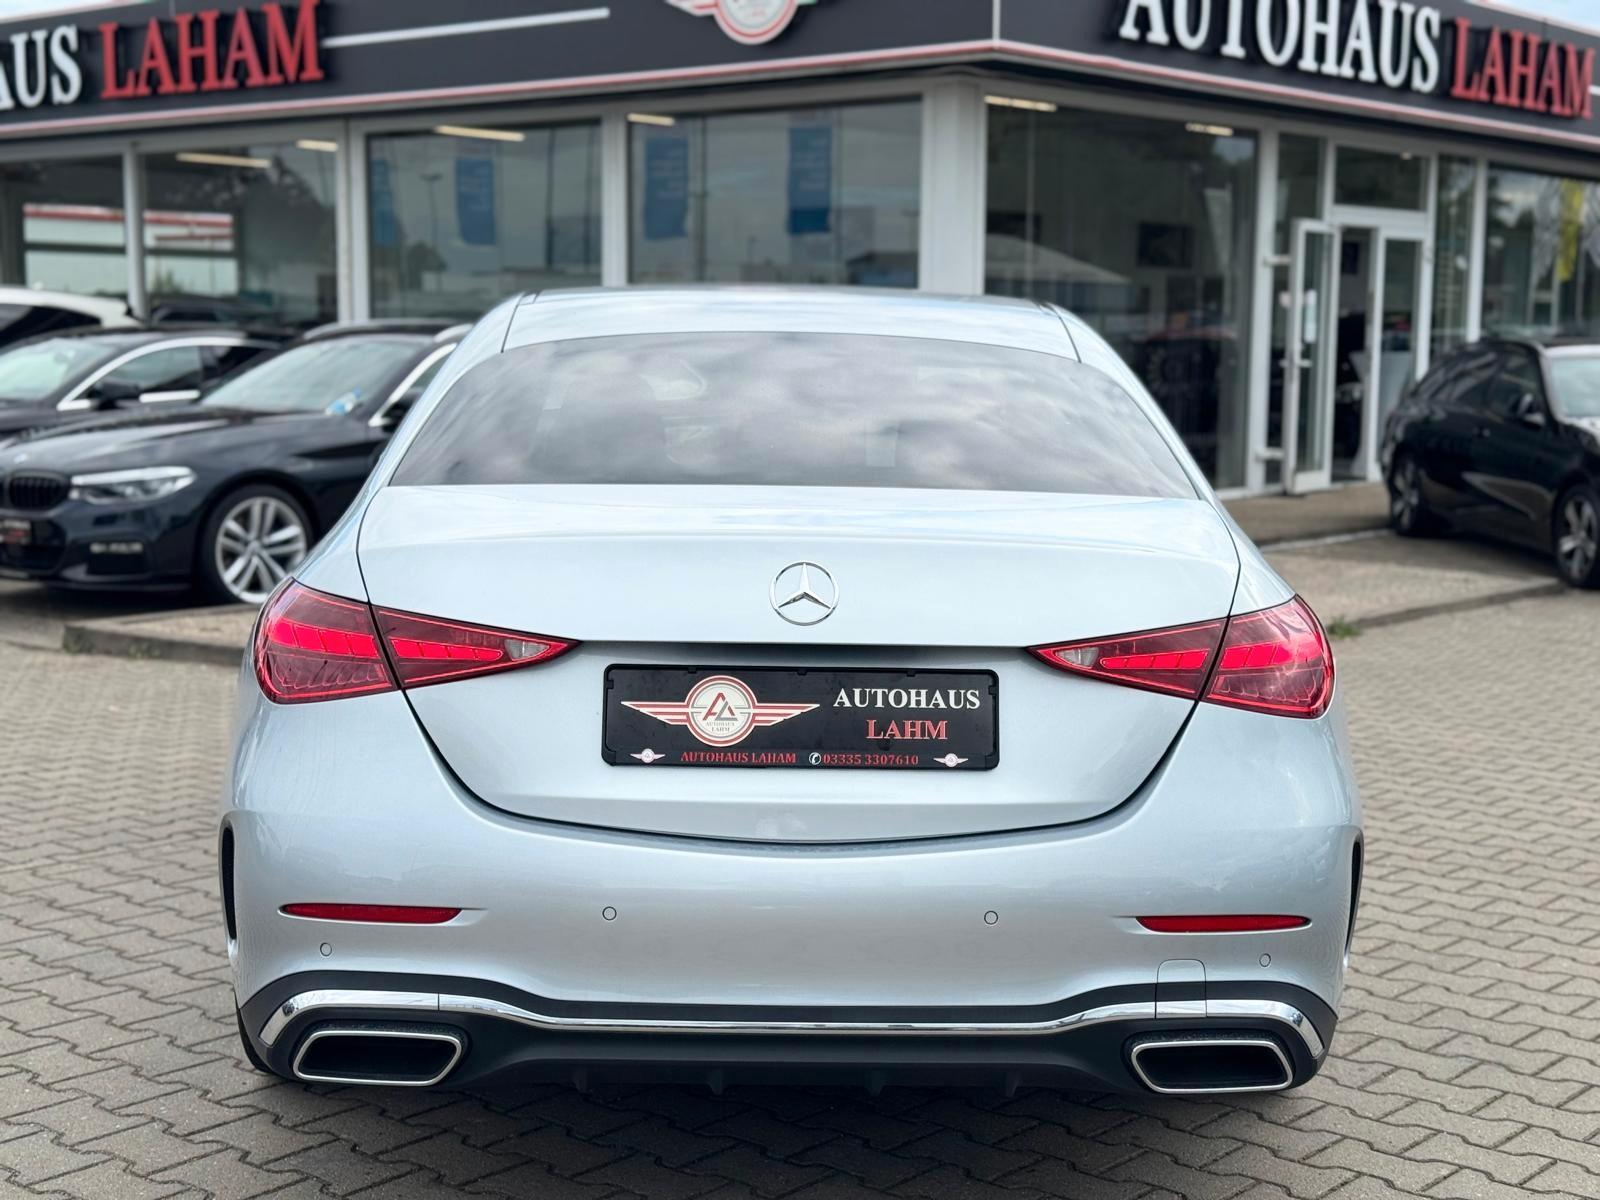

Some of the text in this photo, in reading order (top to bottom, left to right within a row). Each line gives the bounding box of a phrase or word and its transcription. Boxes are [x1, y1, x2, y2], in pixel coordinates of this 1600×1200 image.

[0, 0, 324, 110] US LAHAM
[1451, 16, 1596, 120] LAHAM
[833, 687, 981, 709] AUTOHAUS
[866, 719, 948, 740] LAHM
[680, 752, 919, 765] AUTOHAUS LAHAM 03335 3307610
